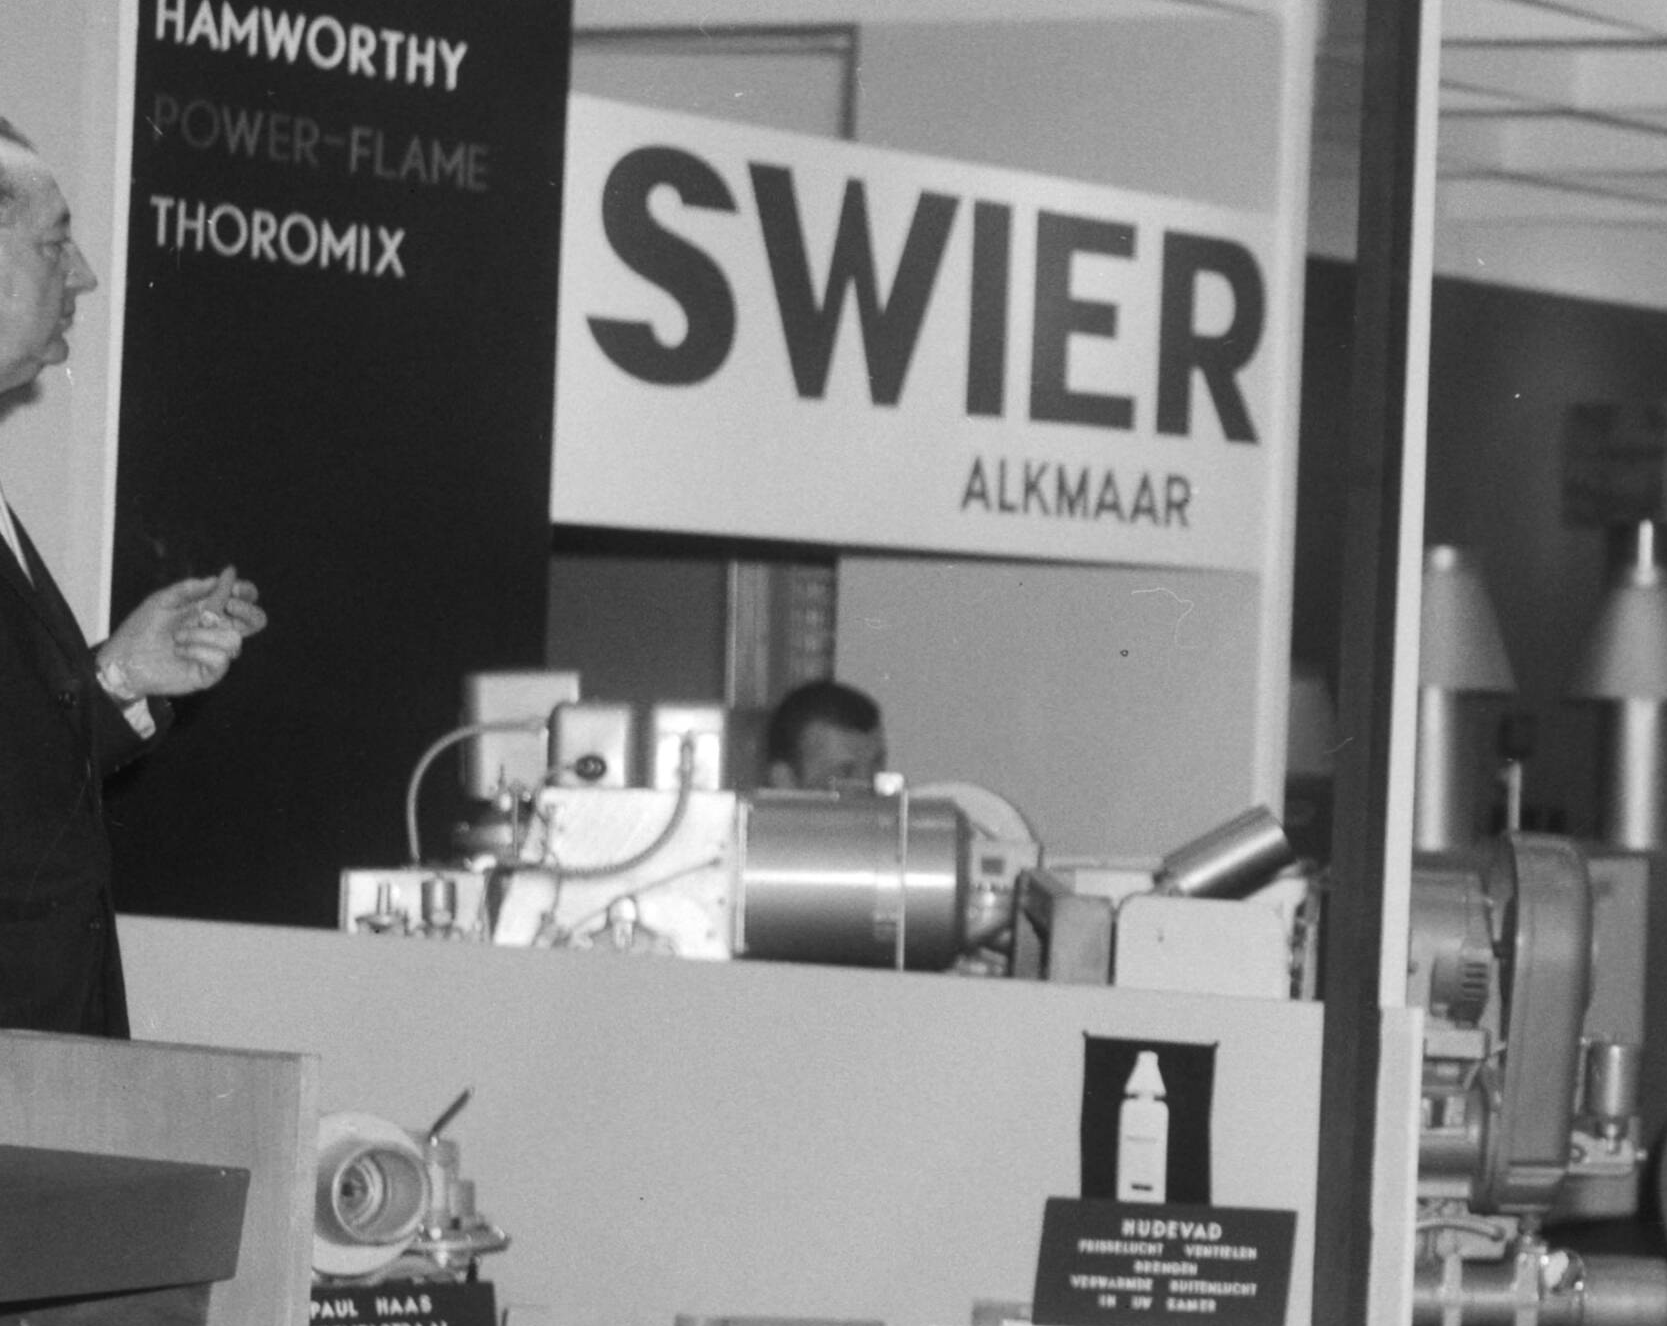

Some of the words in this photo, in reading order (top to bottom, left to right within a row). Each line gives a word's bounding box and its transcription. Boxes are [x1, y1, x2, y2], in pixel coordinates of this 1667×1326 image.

[152, 94, 490, 193] POWER-FLAME
[150, 195, 406, 277] THOROMIX
[586, 145, 1267, 445] SWIER
[961, 456, 1191, 527] ALKMAAR
[309, 1299, 358, 1319] PAUL
[375, 1294, 432, 1316] HAAS
[1069, 1274, 1153, 1291] VERWARMDE
[1169, 1279, 1257, 1297] BUITENLUCHT
[1098, 1294, 1117, 1308] IN
[1131, 1296, 1153, 1310] UW
[1166, 1296, 1217, 1313] KAMER
